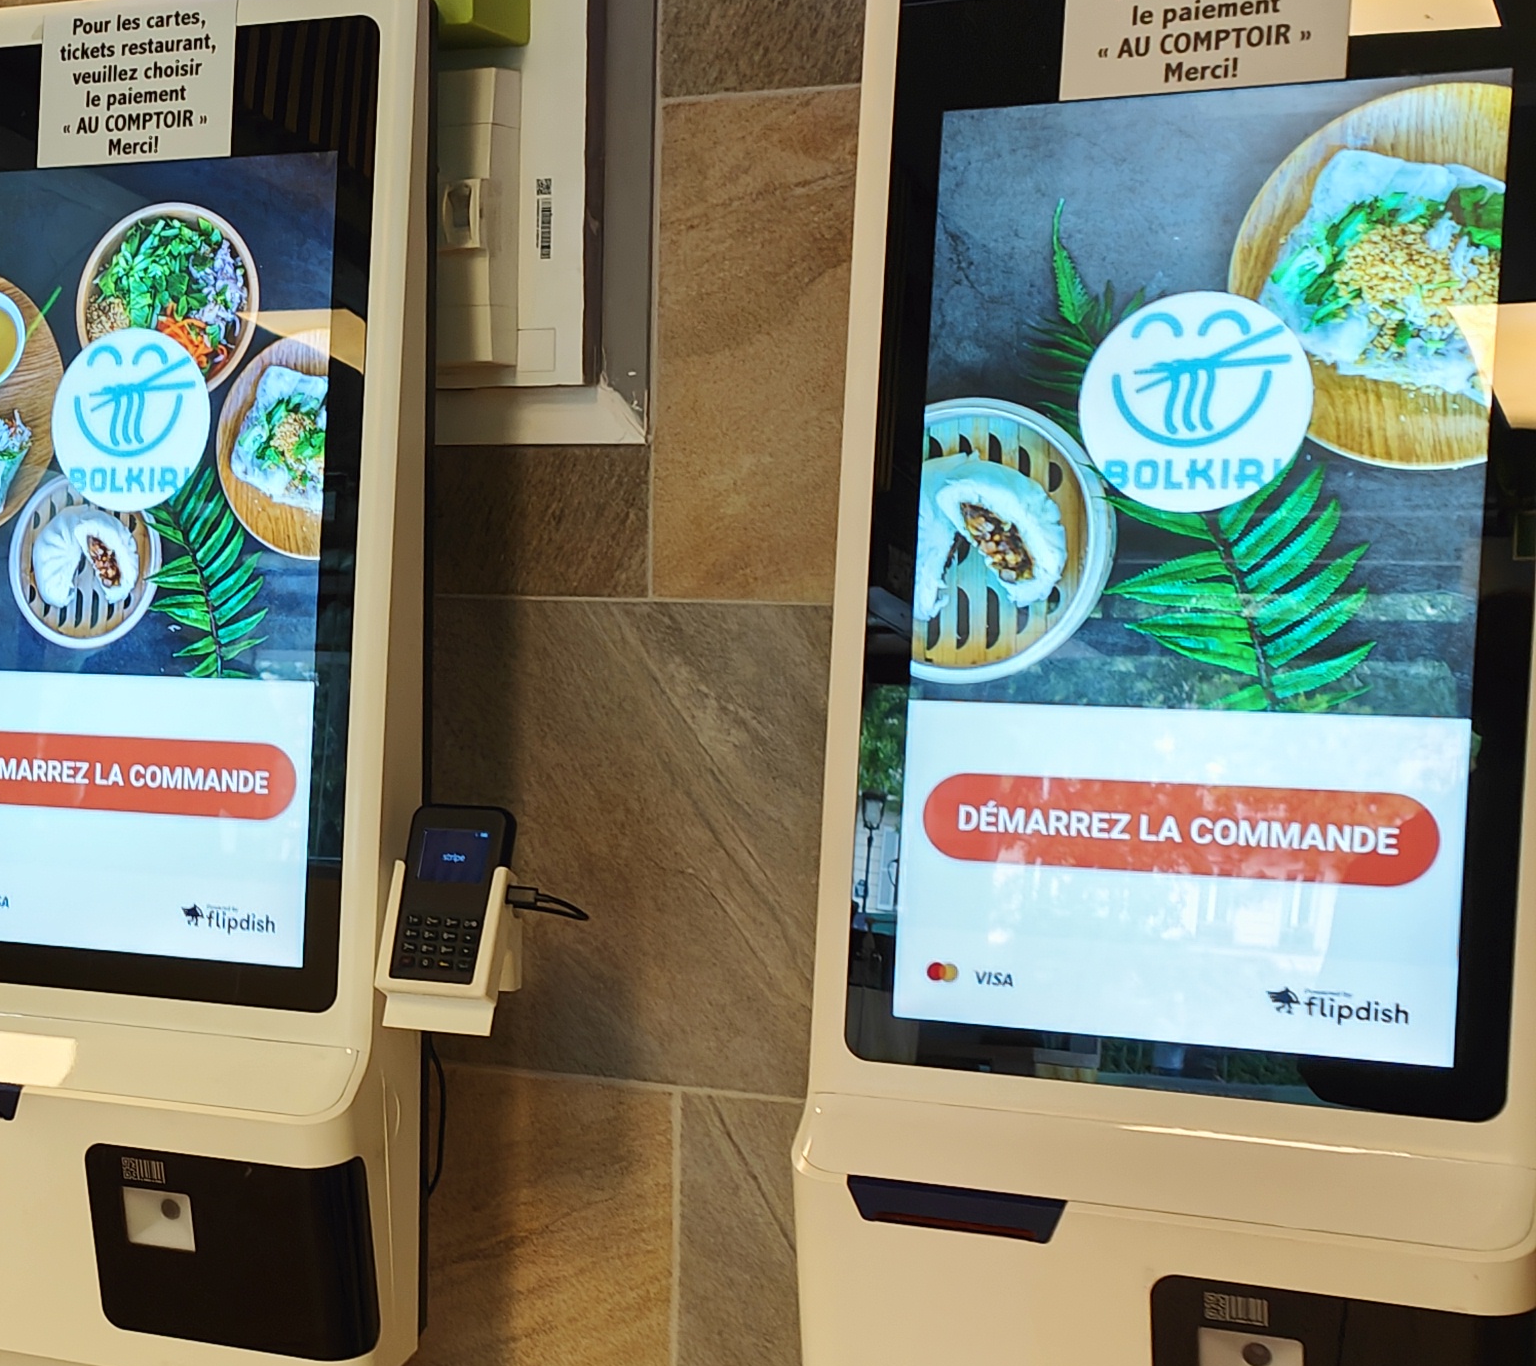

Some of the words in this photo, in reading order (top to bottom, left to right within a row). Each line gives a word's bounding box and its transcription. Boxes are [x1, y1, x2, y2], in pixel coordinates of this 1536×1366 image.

[73, 18, 111, 35] Pour
[117, 14, 140, 32] les
[147, 10, 206, 29] cartes,
[1132, 5, 1153, 26] le
[60, 42, 115, 61] tickets
[121, 33, 216, 56] restaurant,
[1117, 36, 1150, 59] AU
[1160, 24, 1291, 54] COMPTOIR
[73, 65, 138, 85] veuillez
[144, 58, 202, 79] choisir
[1164, 58, 1238, 83] Merci!
[86, 90, 101, 108] le
[107, 85, 186, 111] paiement
[76, 116, 99, 135] AU
[105, 109, 193, 132] COMPTOIR
[108, 136, 159, 156] Merci!
[95, 762, 124, 787] LA
[129, 763, 269, 795] COMMANDE
[958, 800, 1131, 840] DÉMARREZ
[1139, 814, 1182, 843] LA
[1190, 816, 1400, 856] COMMANDE
[206, 910, 275, 935] flipdish
[973, 970, 1013, 987] VISA
[1304, 996, 1409, 1025] flipdish
